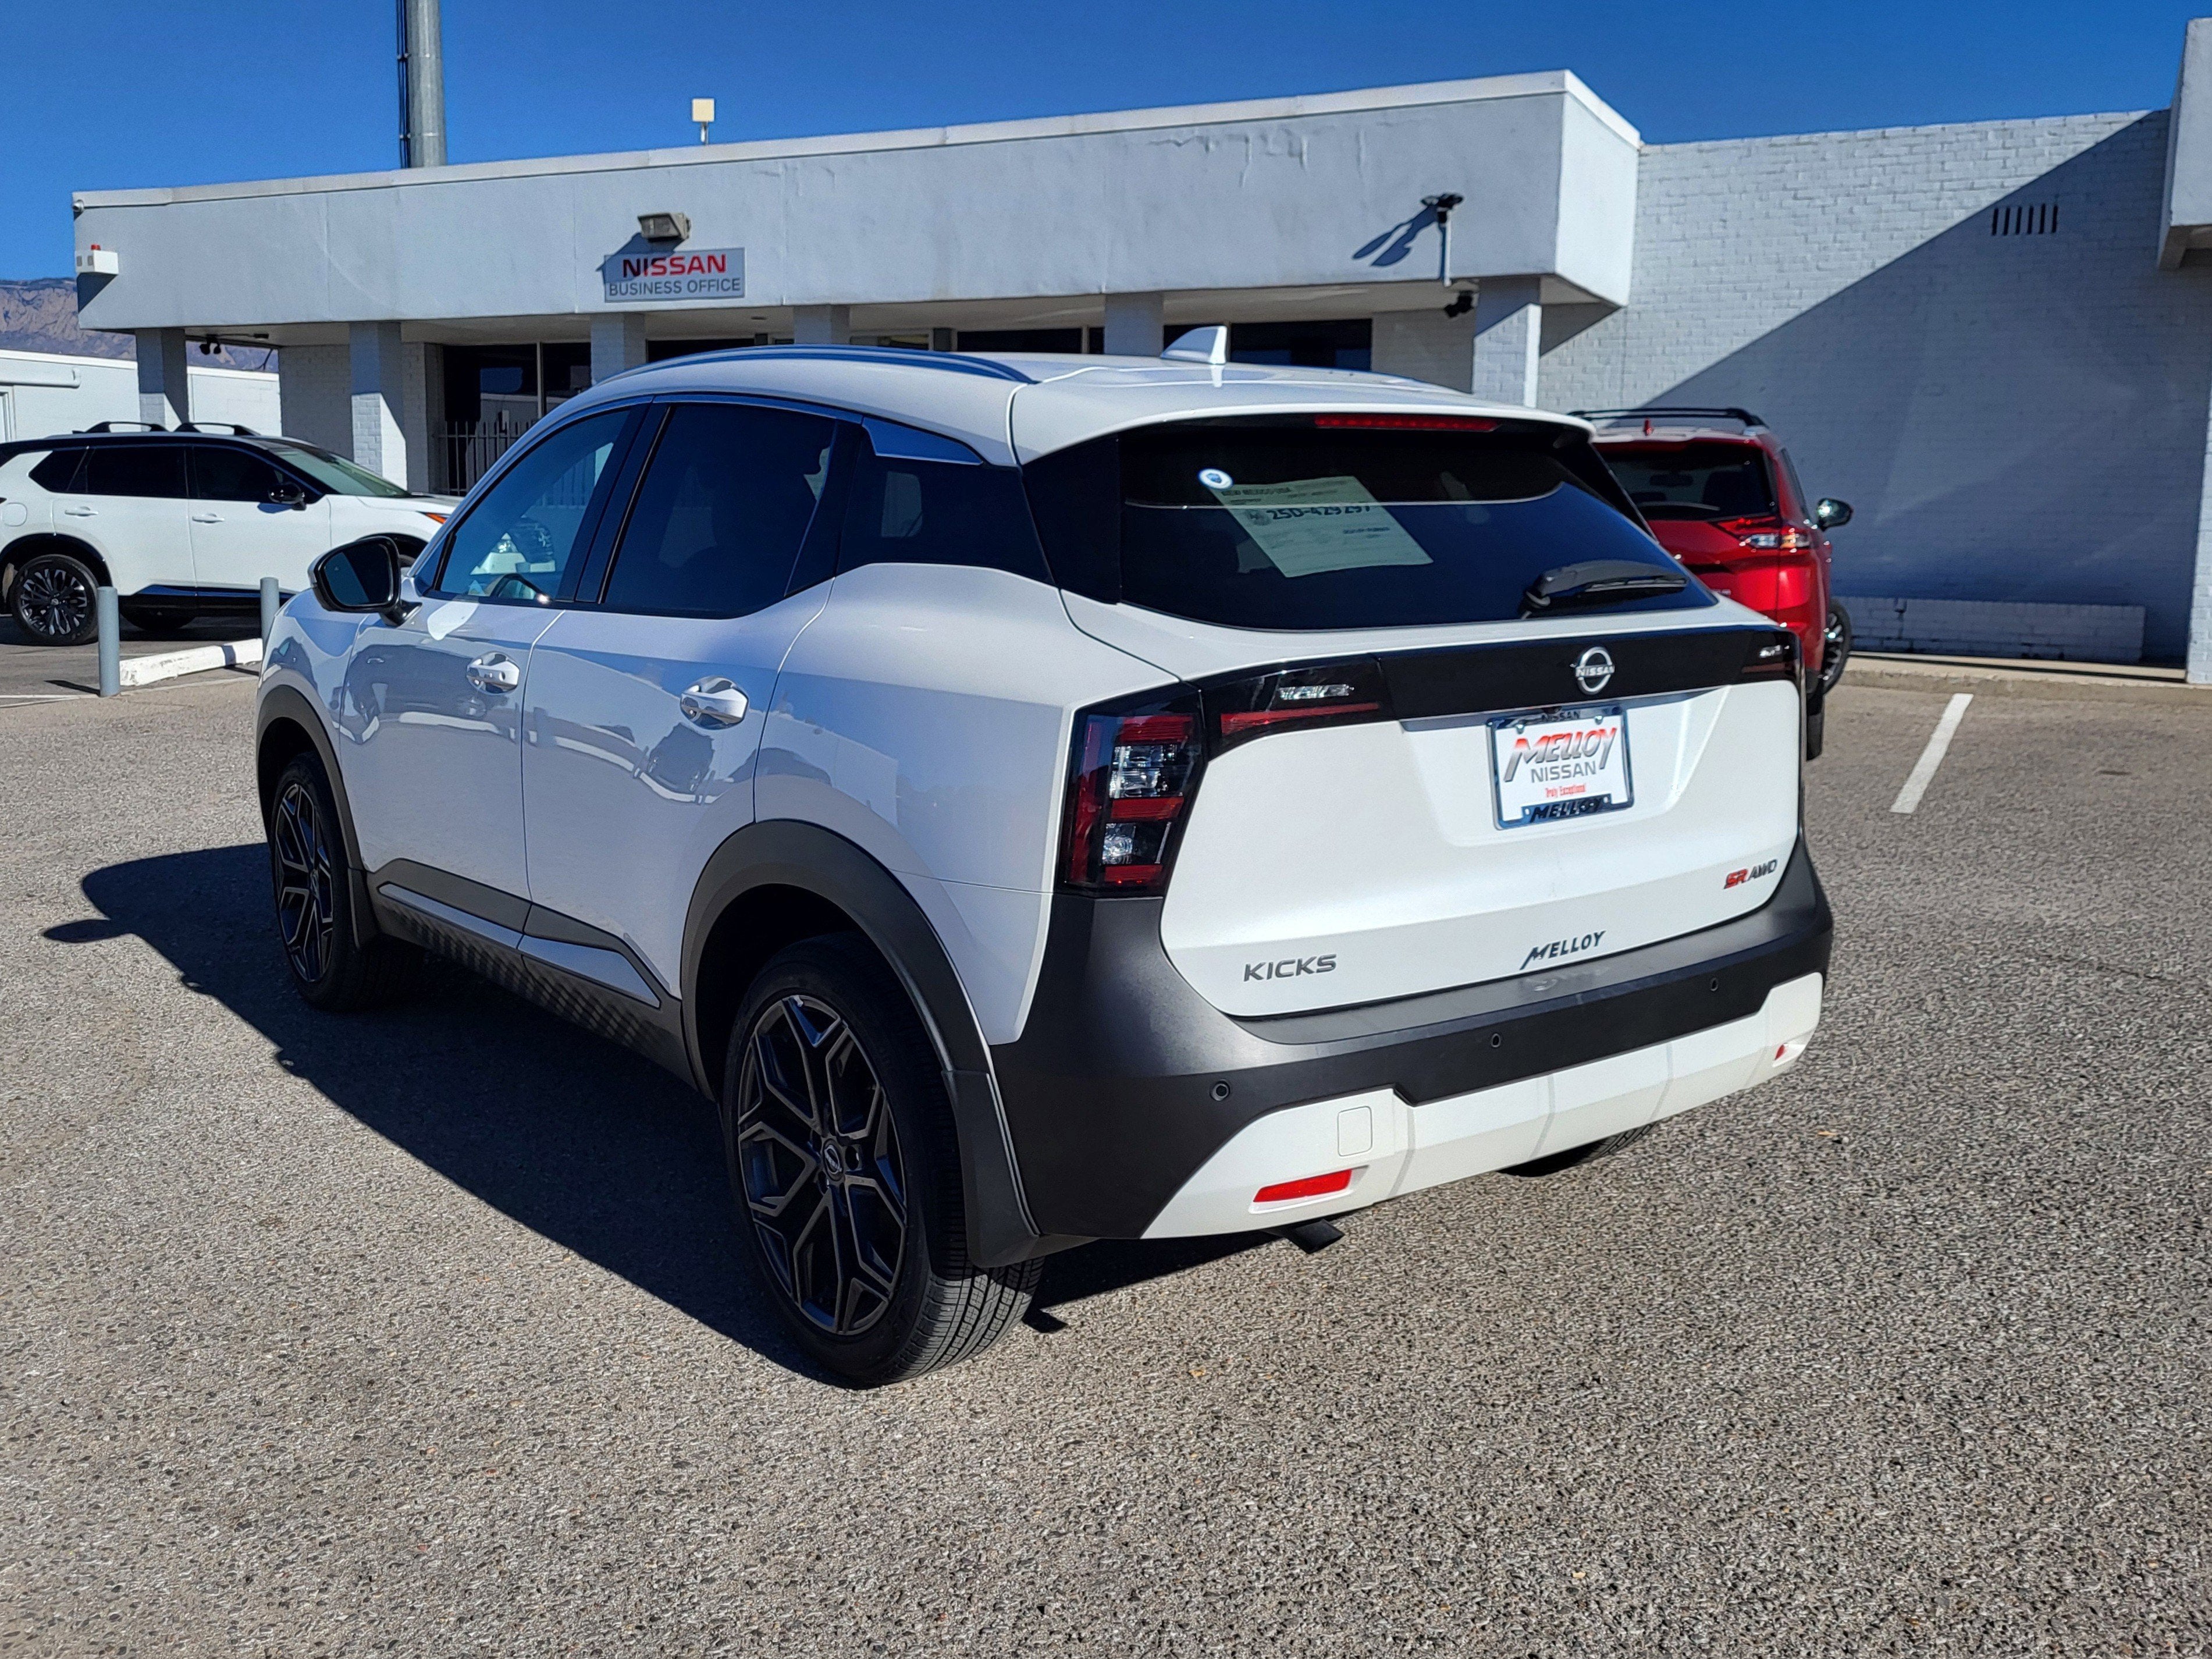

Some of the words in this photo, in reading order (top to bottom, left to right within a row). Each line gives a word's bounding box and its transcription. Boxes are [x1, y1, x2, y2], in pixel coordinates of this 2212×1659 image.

[623, 254, 726, 278] NISSAN
[609, 280, 682, 296] BUSINESS
[687, 277, 741, 293] OFFICE
[1576, 665, 1615, 677] NISSAN
[1503, 727, 1617, 783] MELLOY
[1531, 761, 1596, 783] NISSAN
[1747, 859, 1778, 880] AWD
[1519, 930, 1607, 971] MELLOY
[1243, 953, 1337, 982] KICKS
